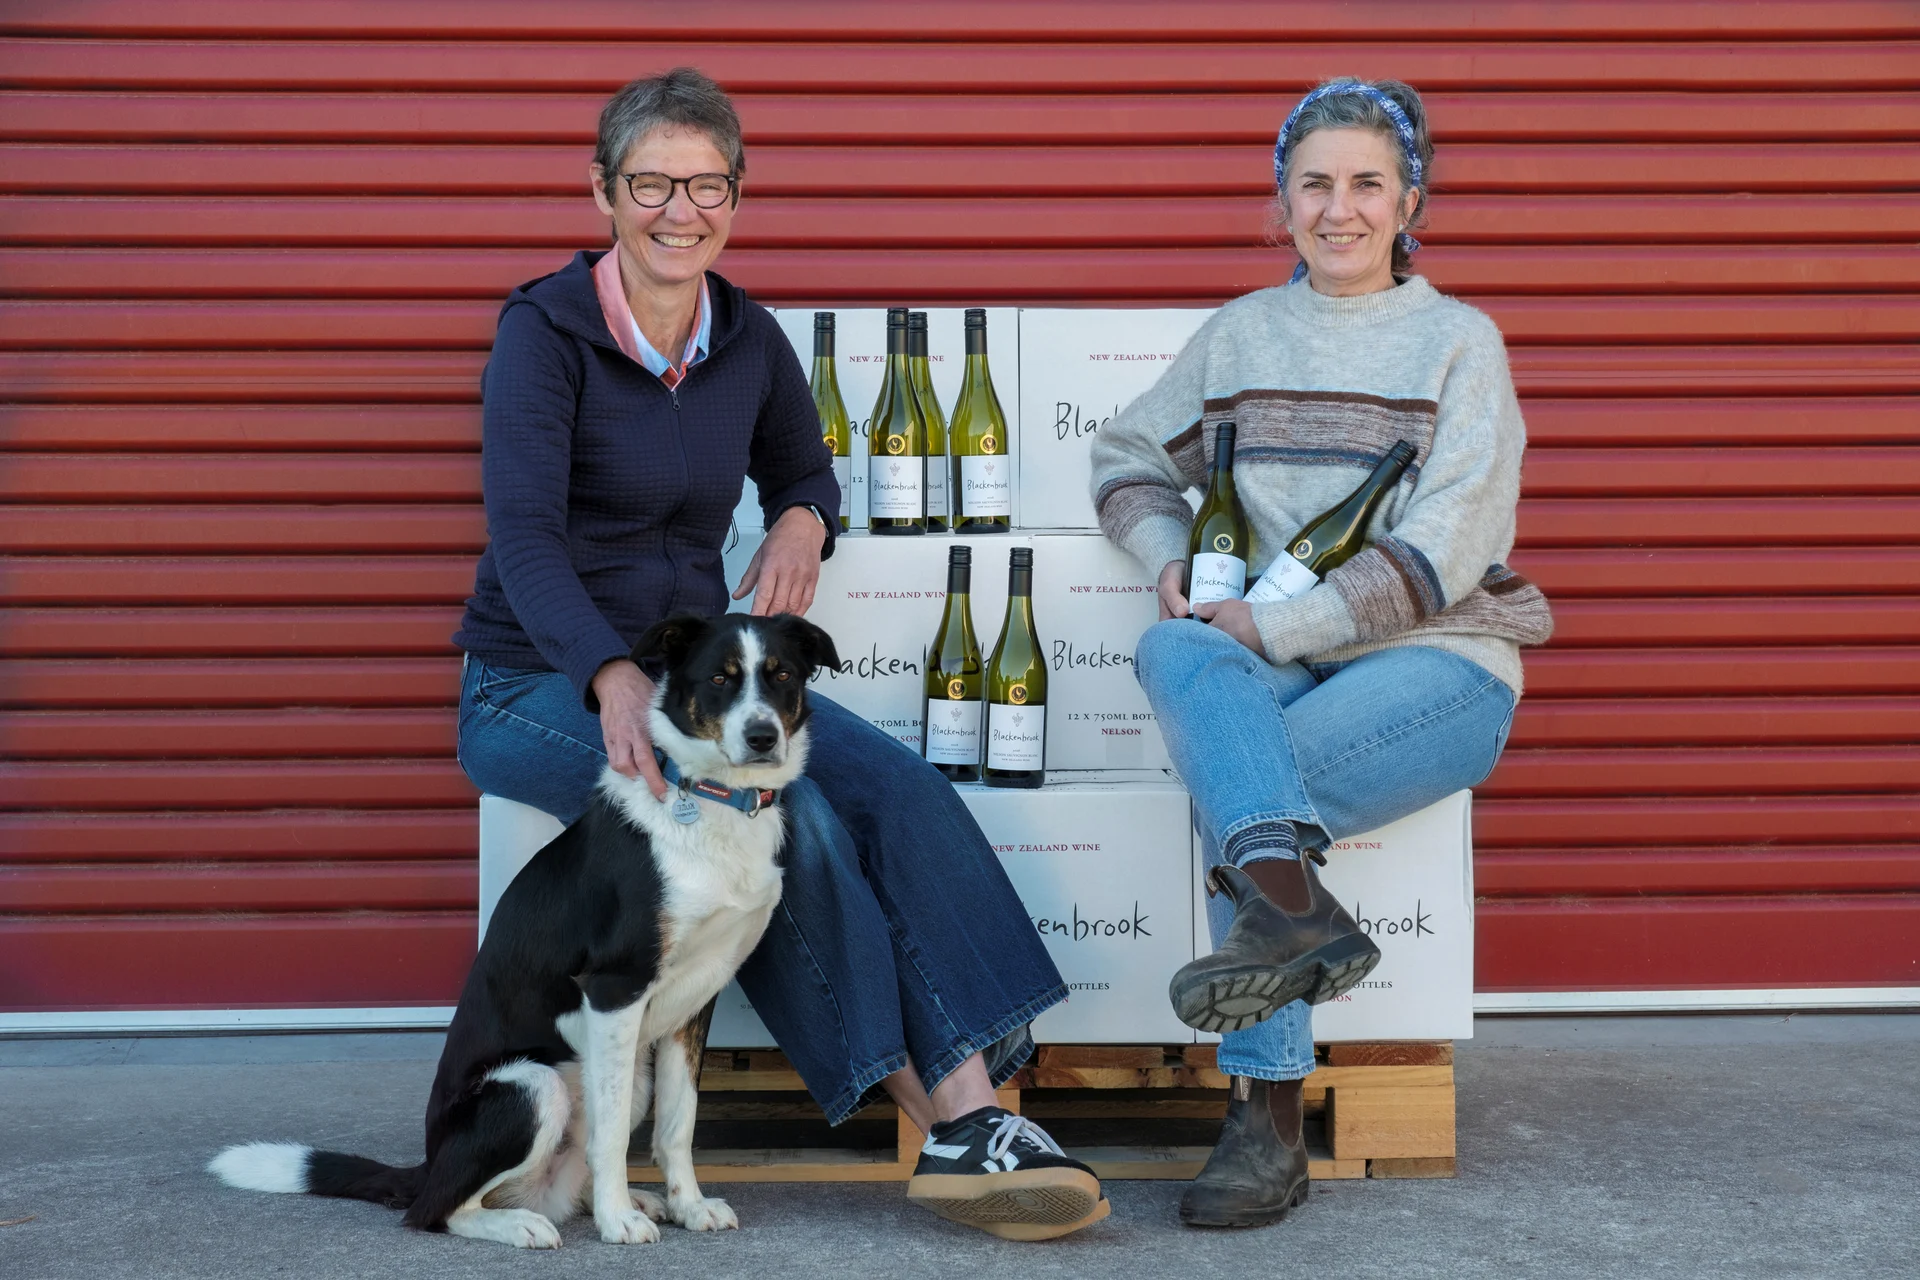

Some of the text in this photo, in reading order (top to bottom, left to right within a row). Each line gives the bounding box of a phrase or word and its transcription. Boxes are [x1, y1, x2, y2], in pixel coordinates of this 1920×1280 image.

[873, 480, 917, 491] Blackenbrook
[967, 479, 1008, 491] Blackenbrook
[1196, 576, 1241, 592] Blackenbrook
[1094, 713, 1128, 722] 750ML
[873, 720, 908, 729] 750ML
[932, 724, 977, 736] Blackenbrook
[993, 729, 1040, 741] Blackenbrook
[1019, 844, 1068, 852] ZEALAND
